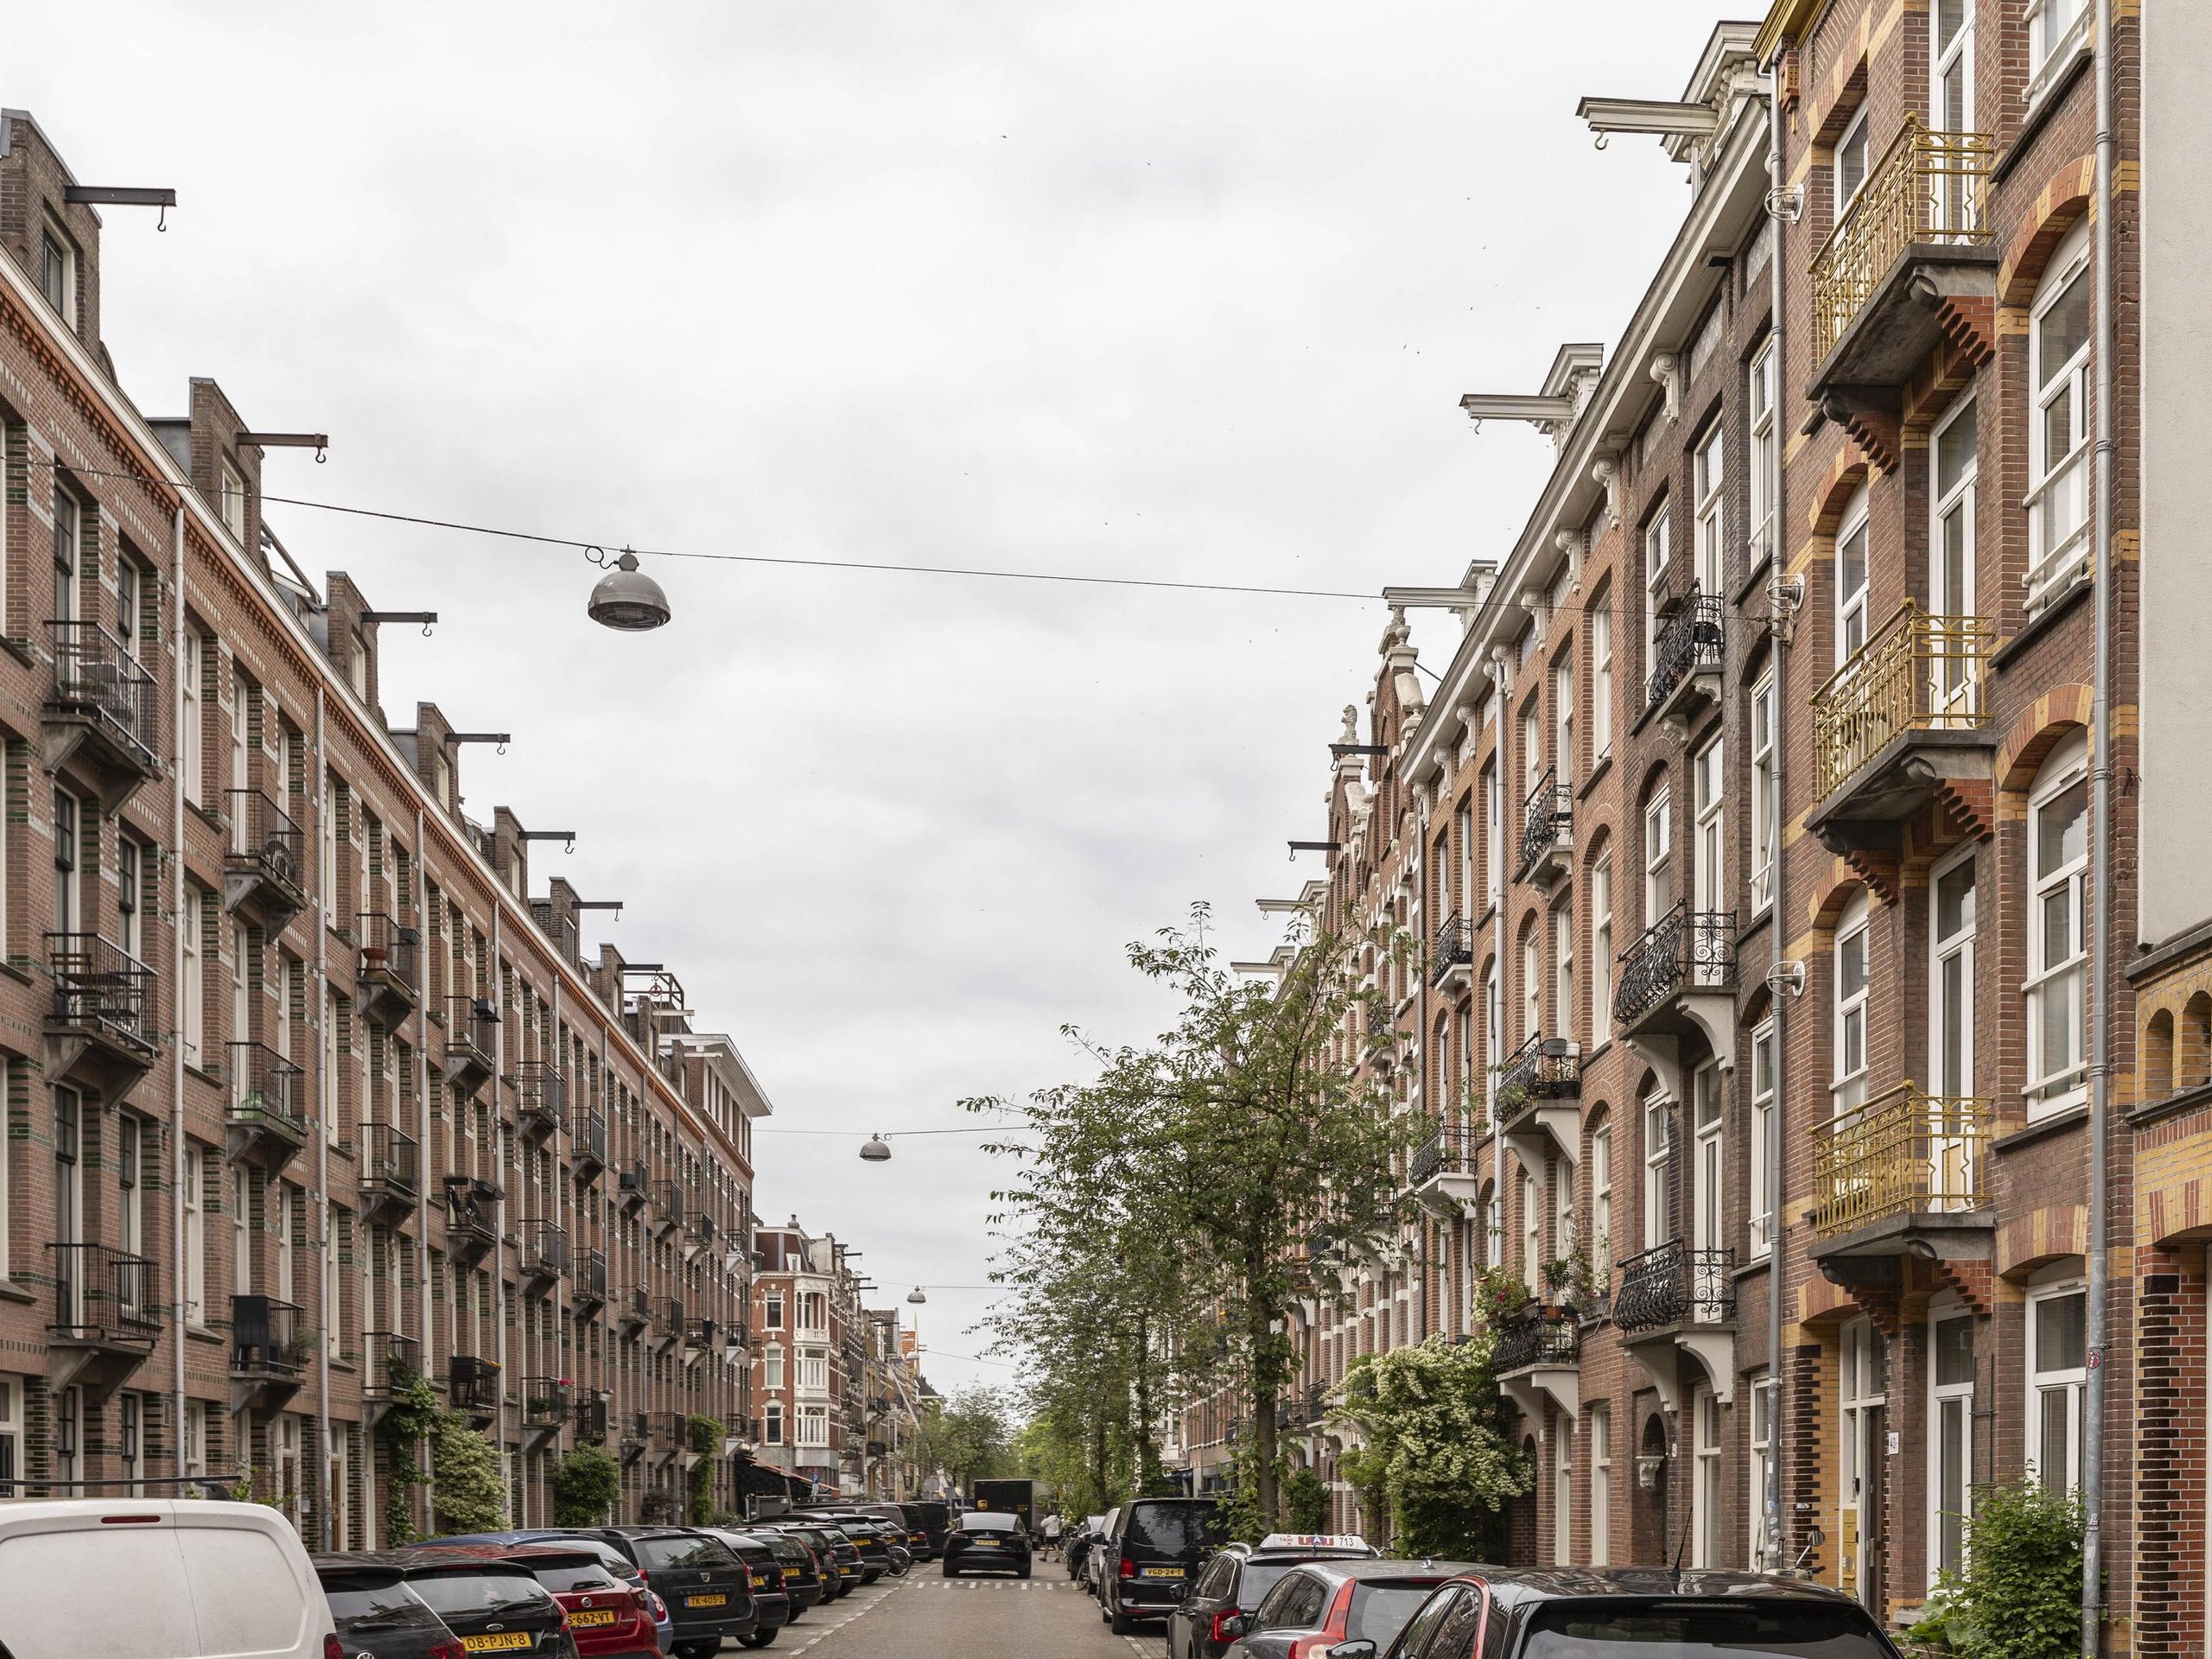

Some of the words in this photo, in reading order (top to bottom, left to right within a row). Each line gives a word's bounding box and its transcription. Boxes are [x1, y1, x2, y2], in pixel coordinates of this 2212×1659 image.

[1338, 1537, 1354, 1547] 713
[690, 1595, 724, 1605] TK-405-Z
[467, 1634, 526, 1649] 08-PJN-8
